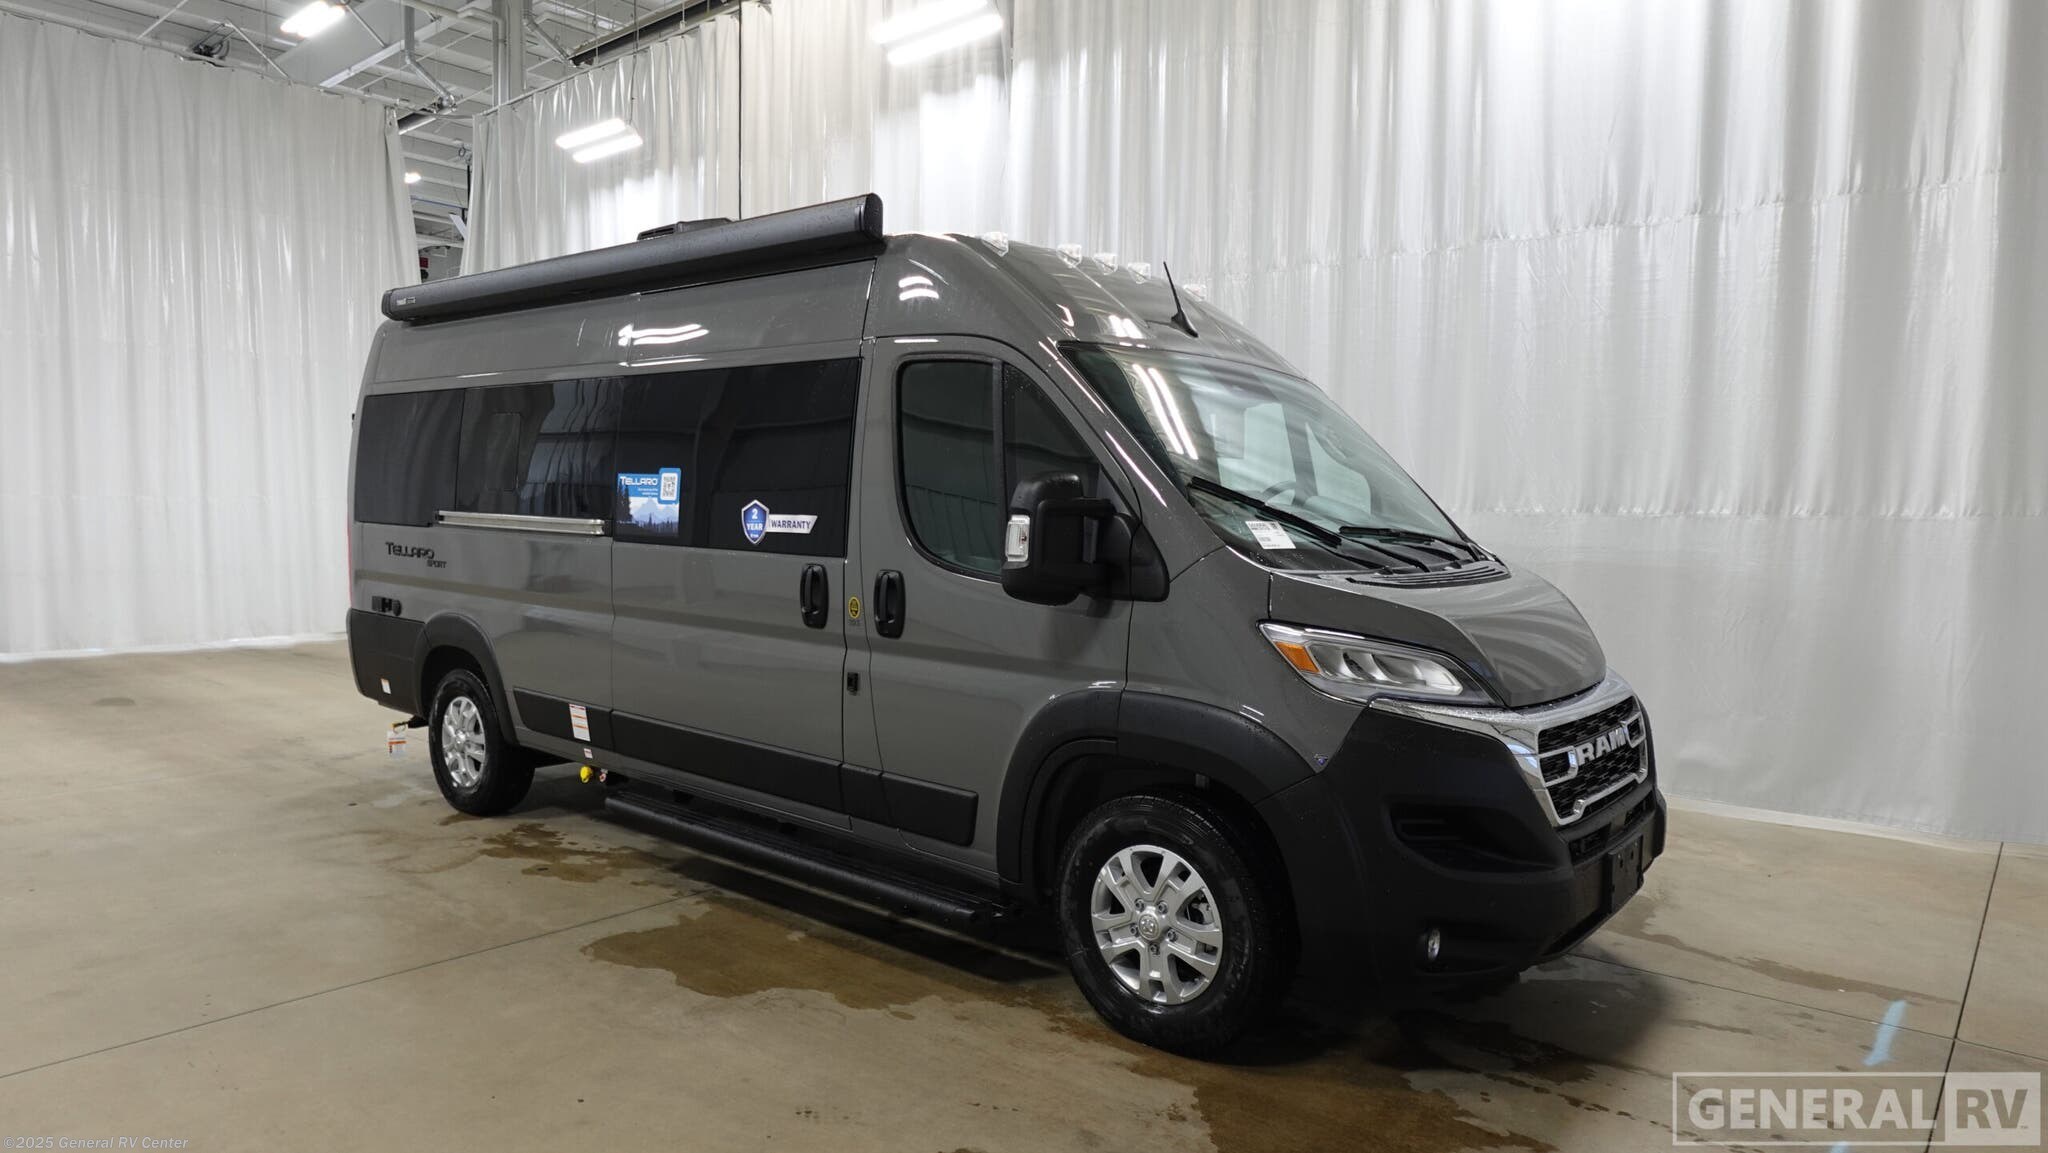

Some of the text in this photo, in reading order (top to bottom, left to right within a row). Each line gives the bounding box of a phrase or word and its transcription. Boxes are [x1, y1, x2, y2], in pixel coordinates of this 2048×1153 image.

[620, 476, 658, 486] TELLARO
[751, 508, 758, 519] 2
[746, 523, 763, 531] YEAR
[771, 519, 811, 529] WARRANTY
[385, 541, 435, 559] TELLARO
[427, 560, 447, 568] SPORT
[1576, 726, 1627, 766] RAM
